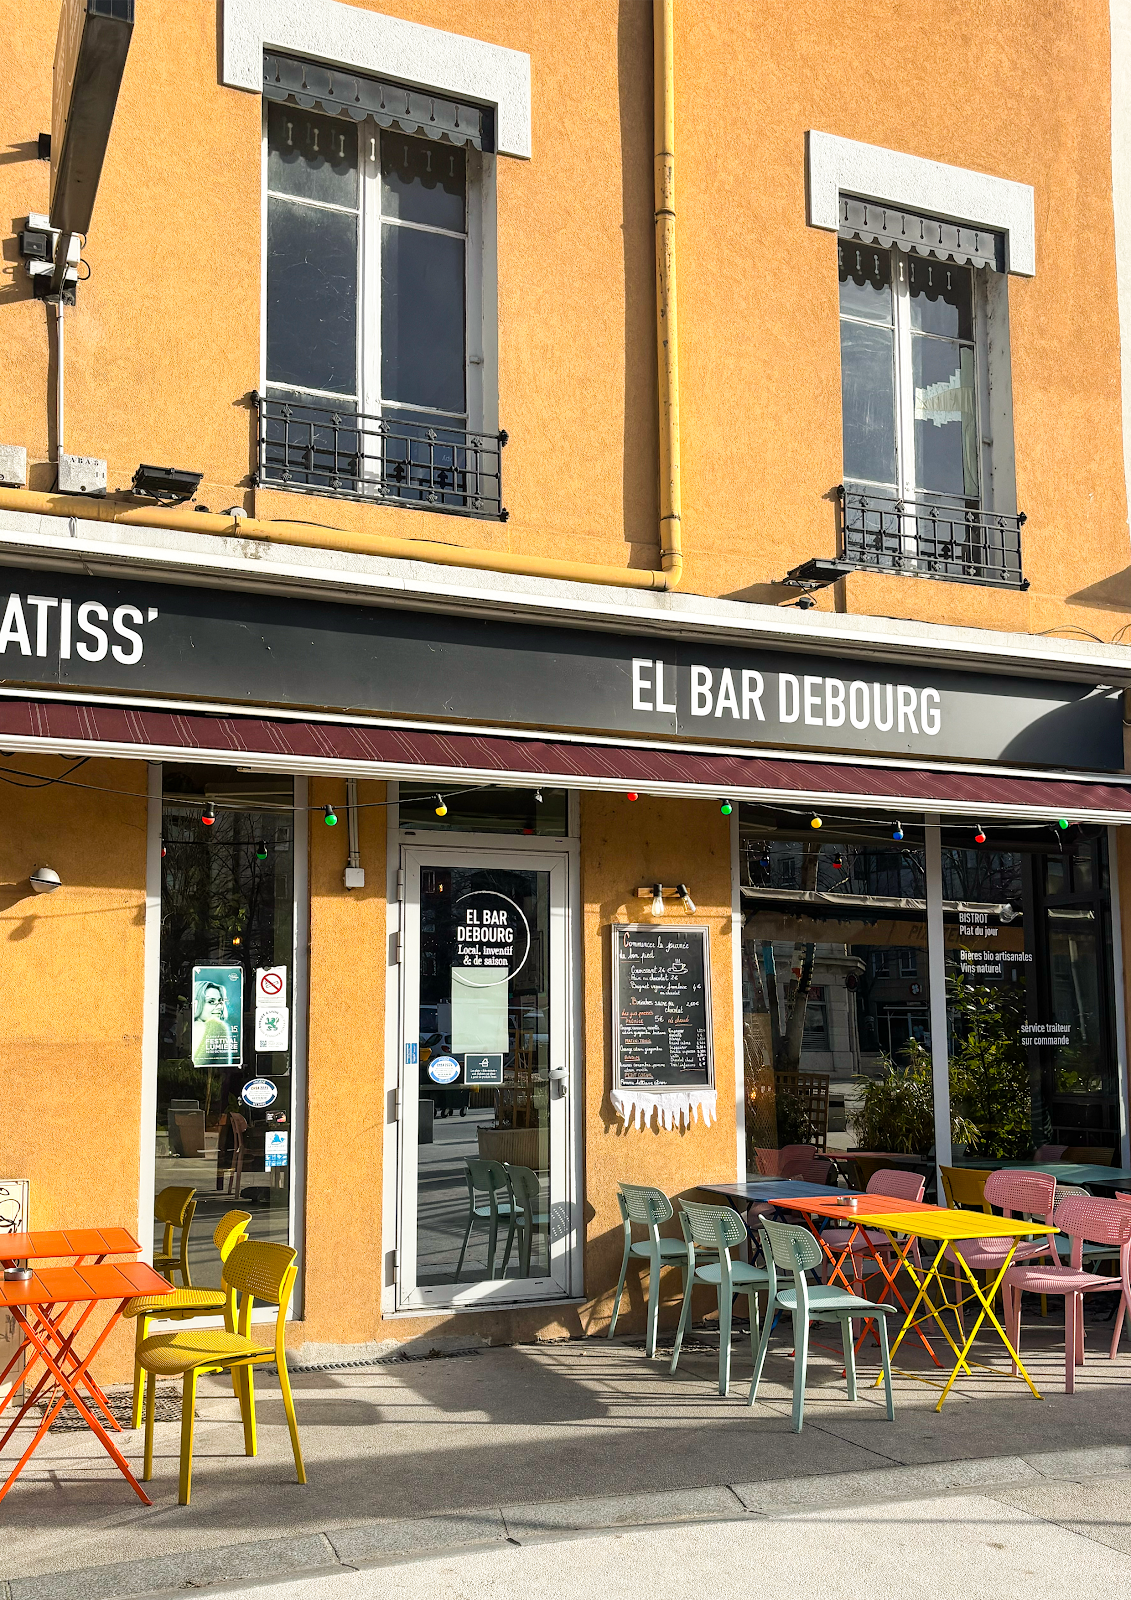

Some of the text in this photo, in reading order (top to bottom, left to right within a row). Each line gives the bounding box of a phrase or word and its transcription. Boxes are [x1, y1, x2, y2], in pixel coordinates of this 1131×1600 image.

[632, 658, 941, 736] EL BAR DEBOURG
[467, 909, 508, 925] EL BAR
[959, 912, 989, 923] BISTROT
[457, 926, 513, 942] DEBOURG
[959, 925, 999, 938] Plat du jour
[457, 944, 513, 956] Local, inventif
[960, 950, 1033, 962] Bières bio artisanales
[463, 955, 509, 965] & de saison
[960, 962, 1002, 974] Vins naturel
[1021, 1023, 1071, 1033] service traiteur
[1021, 1035, 1070, 1046] sur commande
